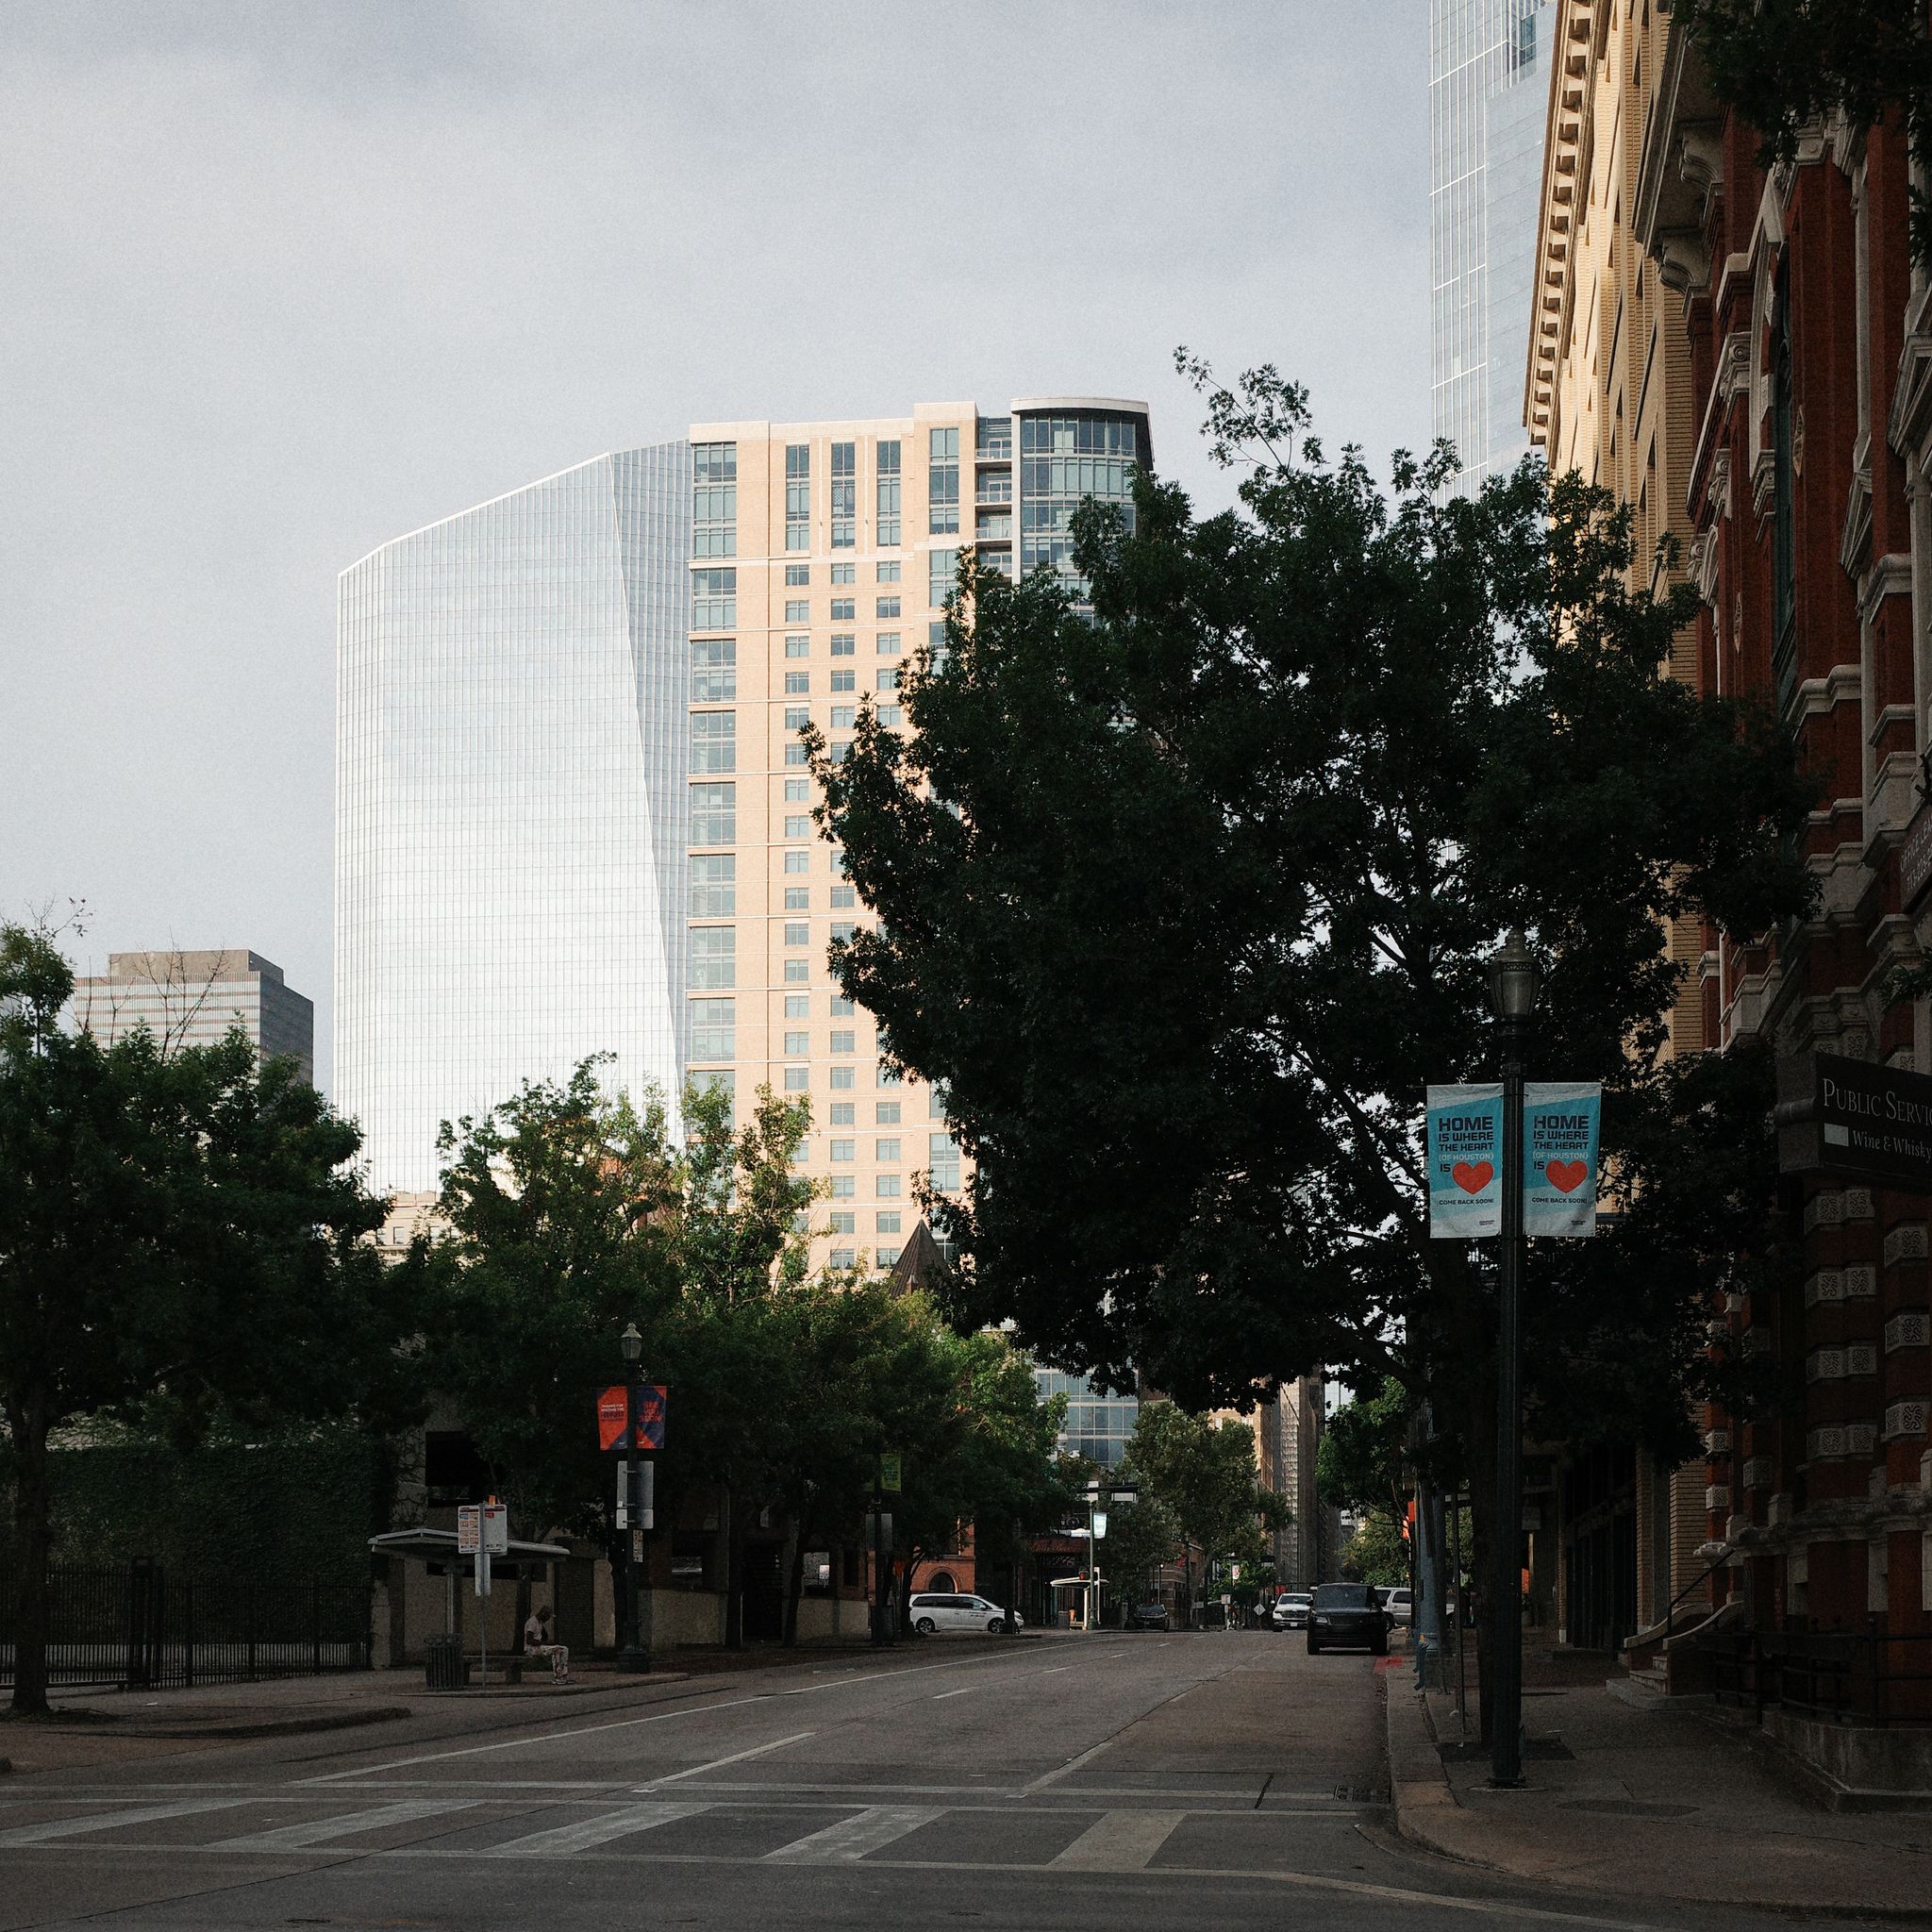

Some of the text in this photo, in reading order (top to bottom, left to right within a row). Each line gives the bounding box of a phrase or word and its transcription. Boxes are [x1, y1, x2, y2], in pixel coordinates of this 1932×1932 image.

[1823, 1077, 1881, 1117] PUBLIC
[1439, 1116, 1493, 1131] HOME
[1534, 1115, 1590, 1129] HOME
[1439, 1132, 1493, 1141] IS WHERE
[1534, 1130, 1589, 1140] IS WHERE
[1439, 1142, 1494, 1152] THE HEART
[1853, 1130, 1932, 1164] Wine & Whisky
[1439, 1153, 1453, 1161] (OF
[1548, 1151, 1589, 1159] HOUSTON)
[1440, 1164, 1451, 1173] IS
[1534, 1161, 1545, 1170] IS
